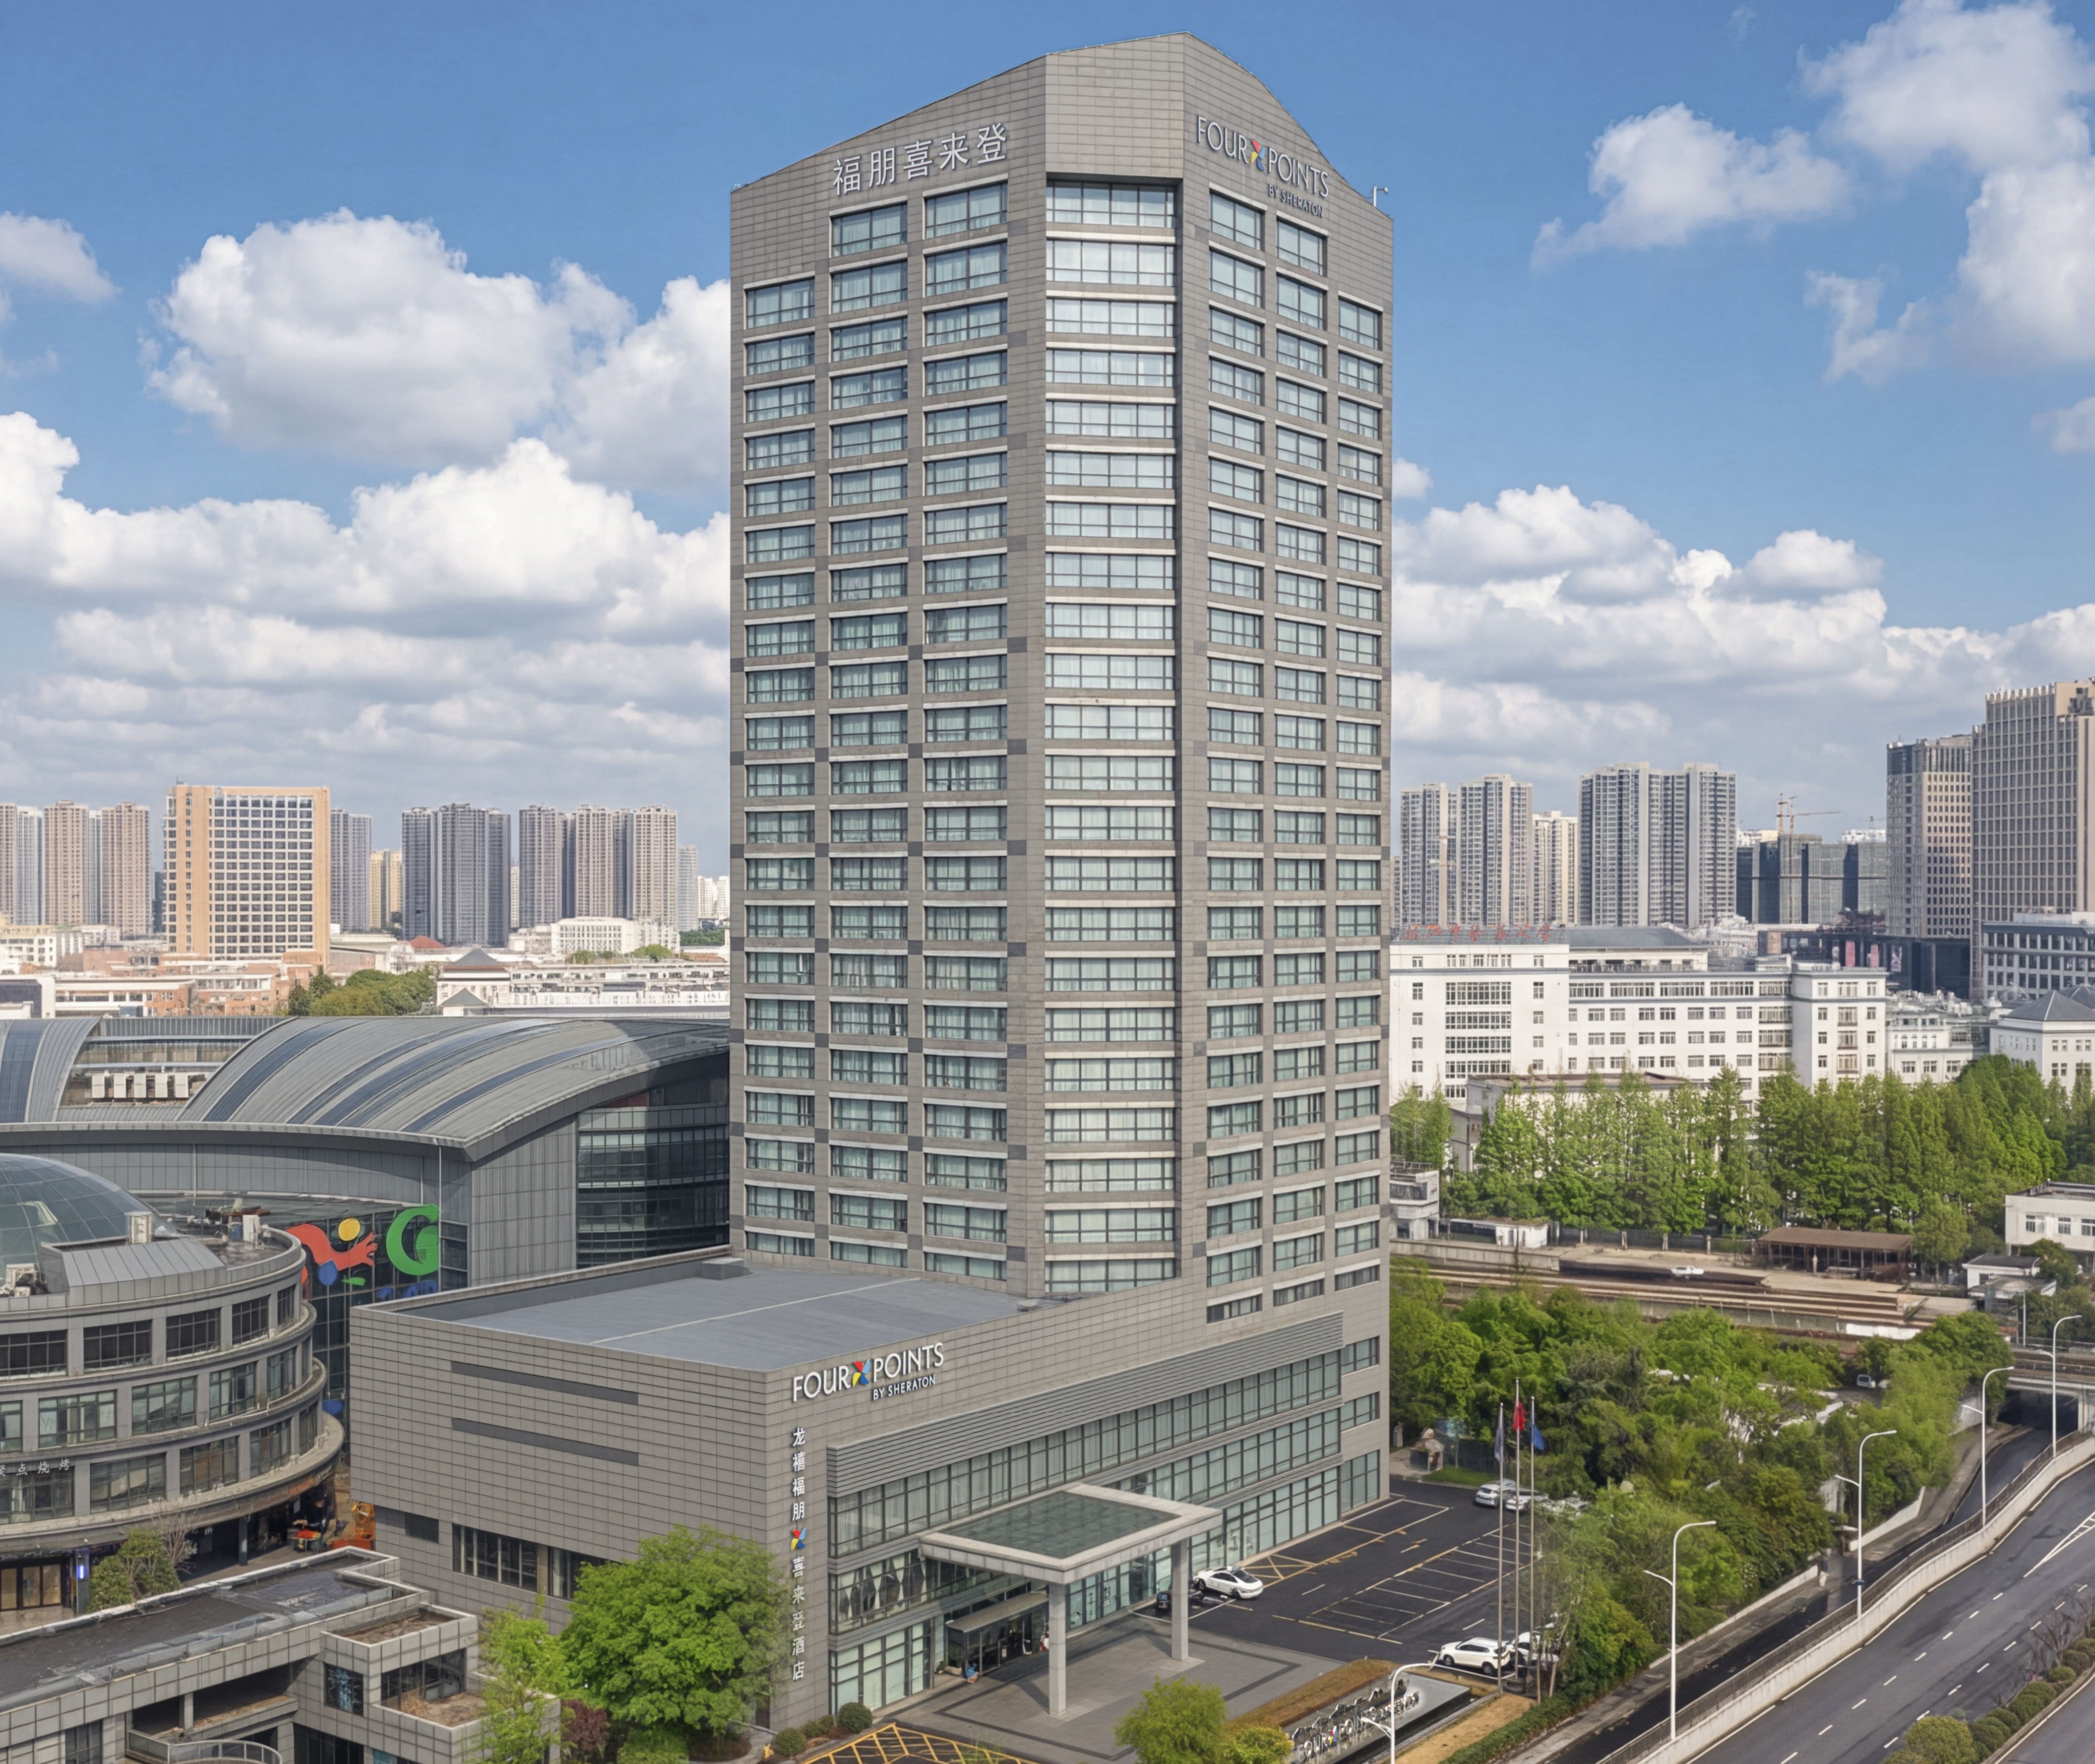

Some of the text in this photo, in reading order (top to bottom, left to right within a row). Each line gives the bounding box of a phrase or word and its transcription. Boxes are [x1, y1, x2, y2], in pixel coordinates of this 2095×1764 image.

[833, 122, 1007, 196] 福朋喜来登
[1197, 115, 1329, 197] FOUR POINTS
[1268, 184, 1324, 218] BY SHERATON
[793, 1342, 944, 1402] FOUR POINTS
[873, 1375, 935, 1400] BY SHERATON
[1298, 1733, 1328, 1762] FOUR
[1339, 1706, 1376, 1740] POINTS
